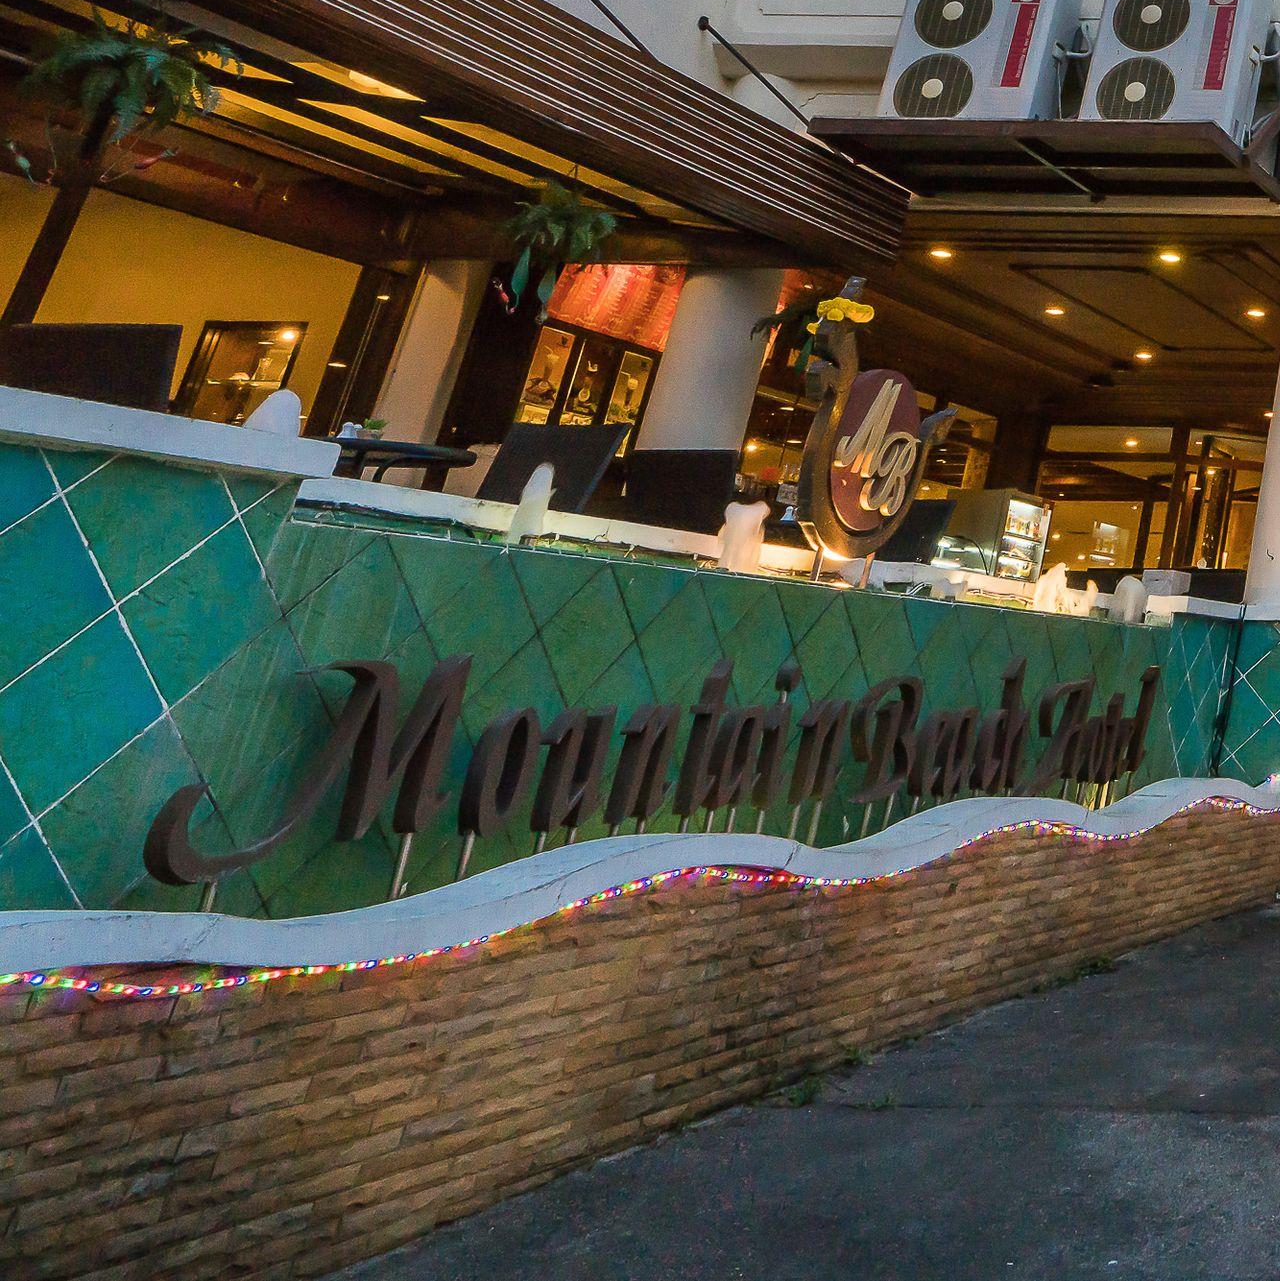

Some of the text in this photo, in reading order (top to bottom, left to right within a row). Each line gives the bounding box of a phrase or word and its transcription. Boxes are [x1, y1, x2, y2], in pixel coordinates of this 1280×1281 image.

[143, 652, 1161, 886] Mountain Beach Hotel
